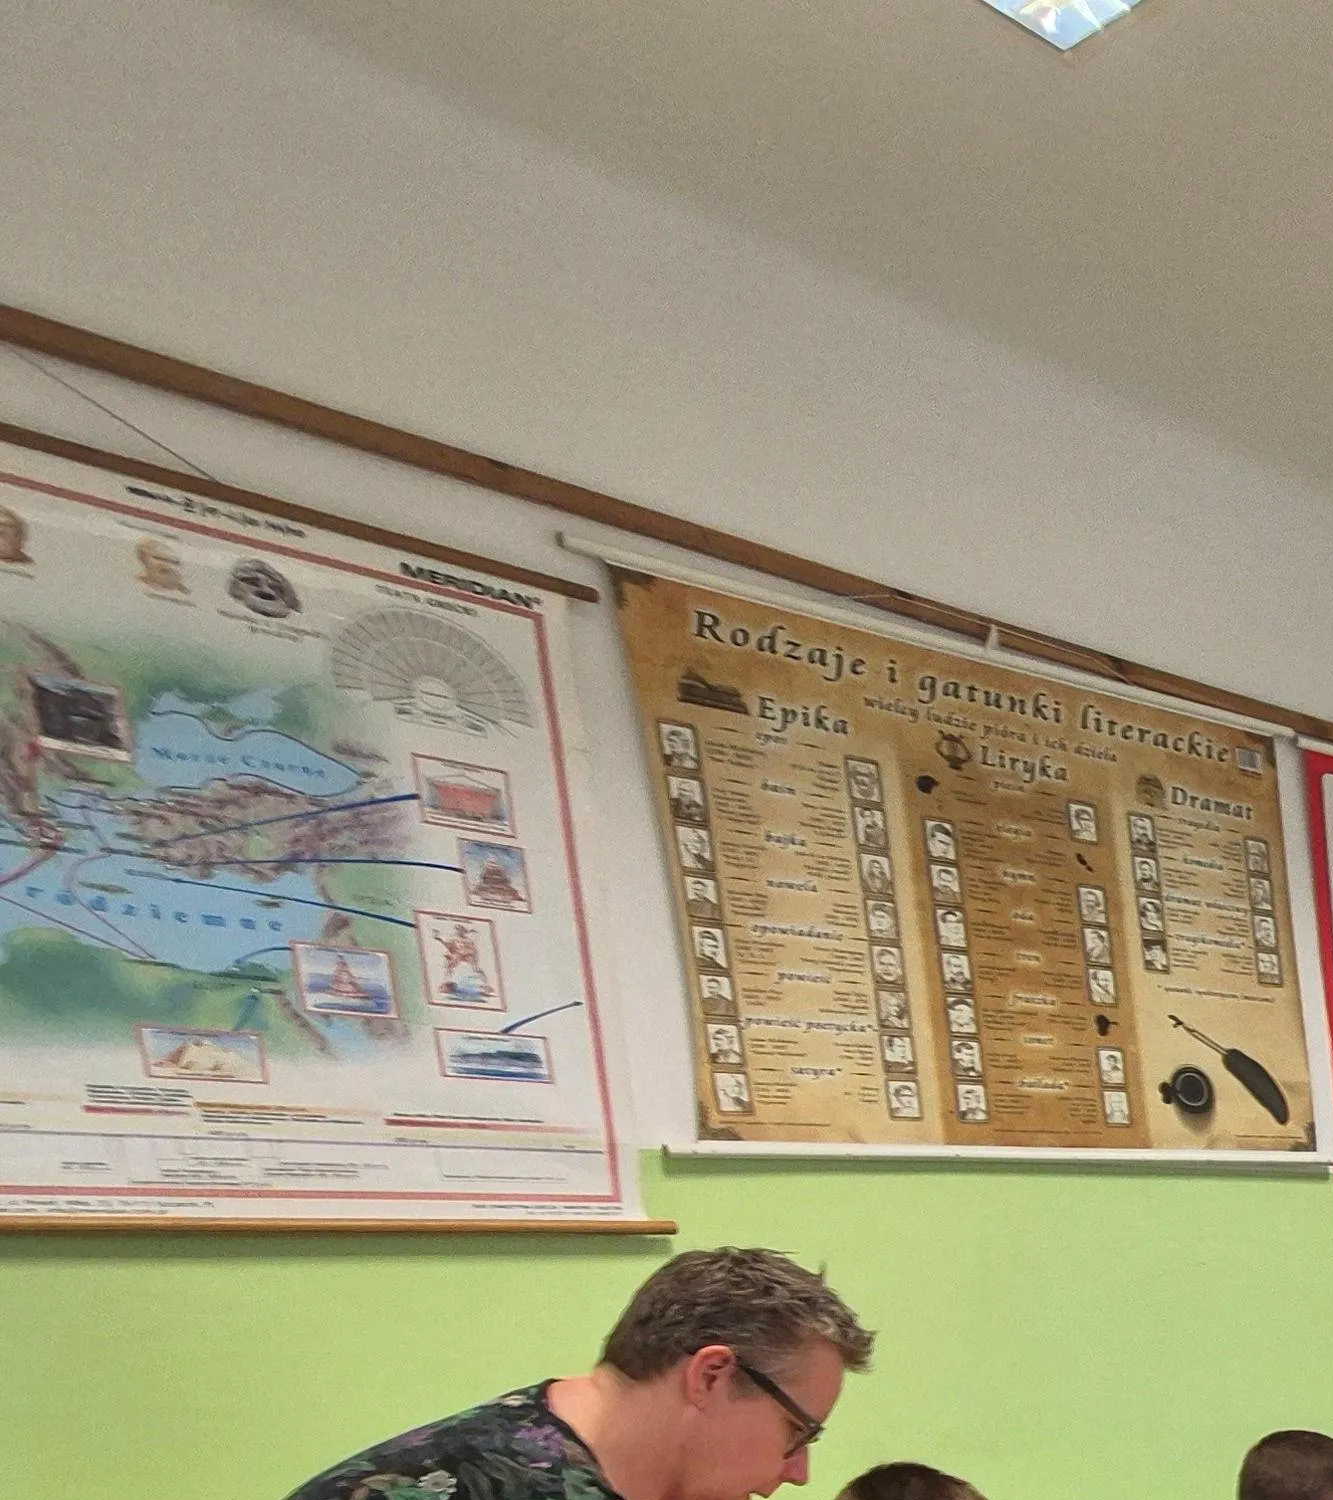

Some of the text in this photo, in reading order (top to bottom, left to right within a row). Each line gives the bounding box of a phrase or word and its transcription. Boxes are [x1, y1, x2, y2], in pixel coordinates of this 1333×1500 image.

[692, 610, 1230, 764] Rodzaje i gatunki literackie
[755, 695, 850, 736] Epika
[977, 744, 1069, 789] Liryka
[1170, 786, 1254, 821] Dramat
